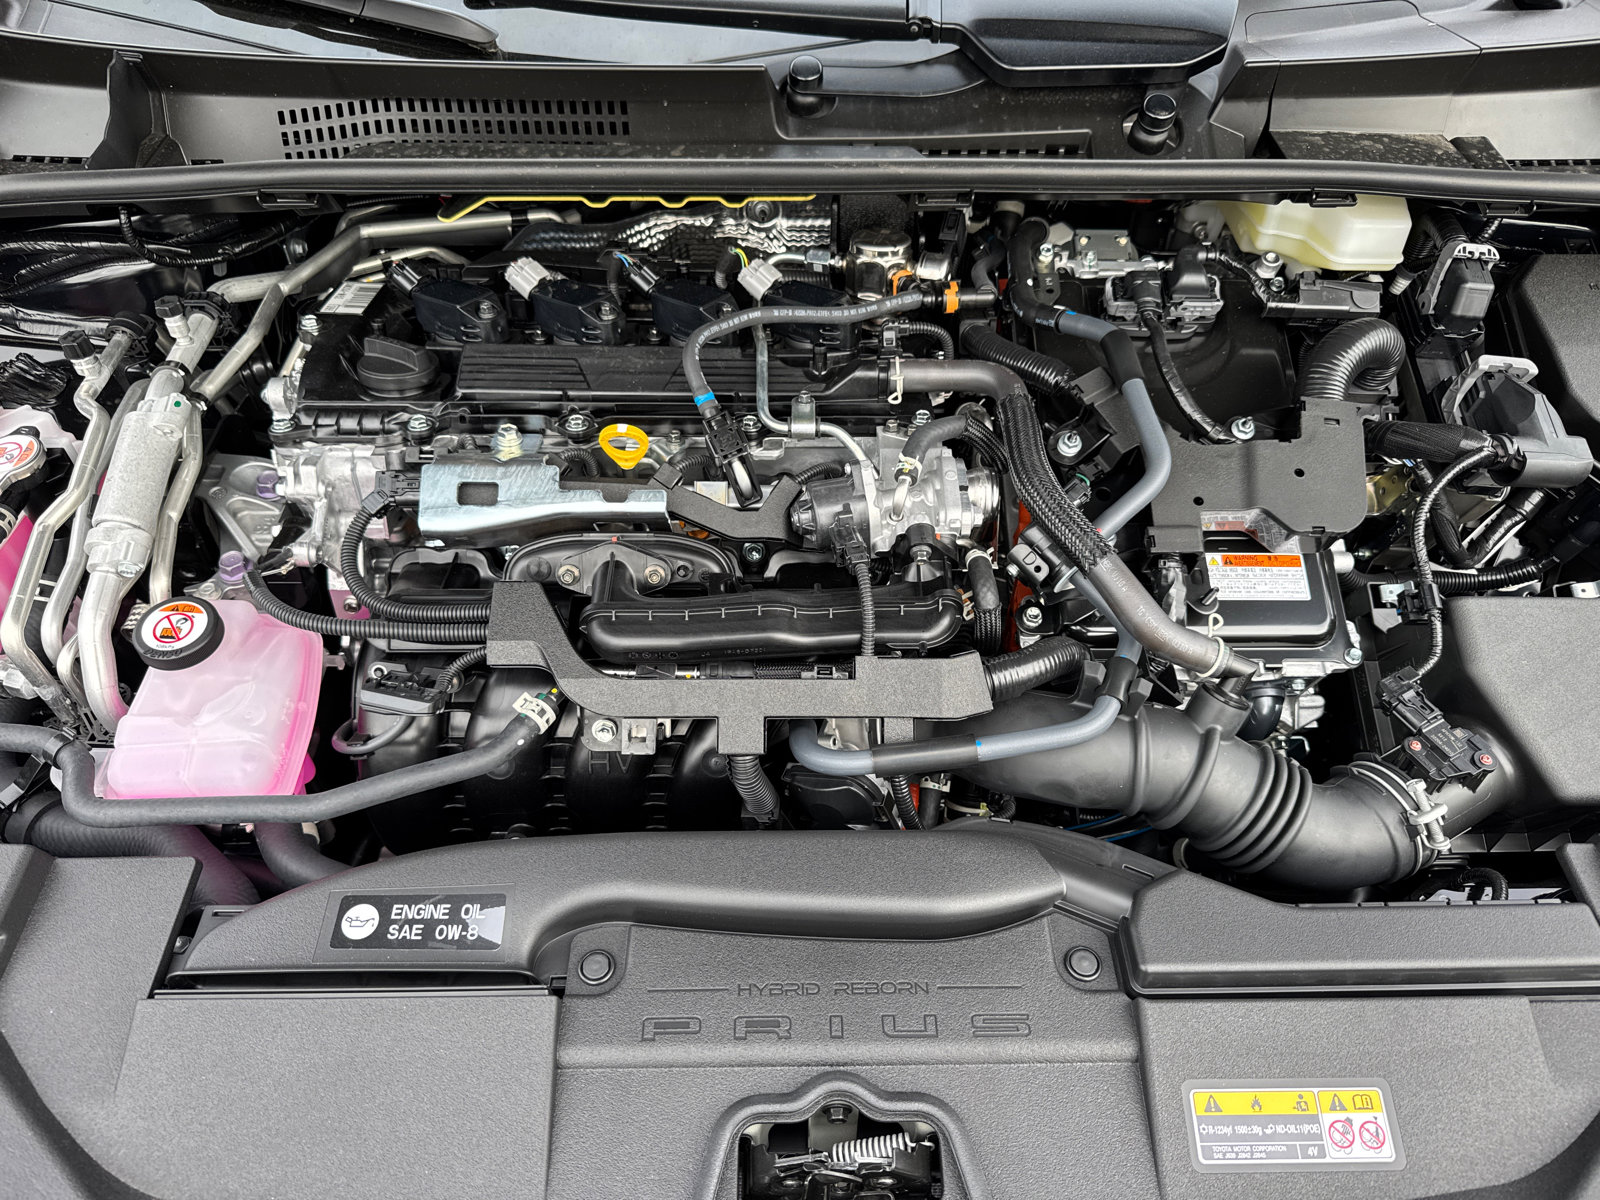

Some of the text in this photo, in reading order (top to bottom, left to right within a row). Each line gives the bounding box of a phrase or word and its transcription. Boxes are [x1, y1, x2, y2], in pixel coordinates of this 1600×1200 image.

[143, 649, 182, 658] DENSO
[390, 903, 486, 920] ENGINE OIL
[386, 924, 479, 941] SAE 0W-8
[737, 981, 929, 997] HYBRID REBORN
[641, 1013, 1032, 1042] PRIUS
